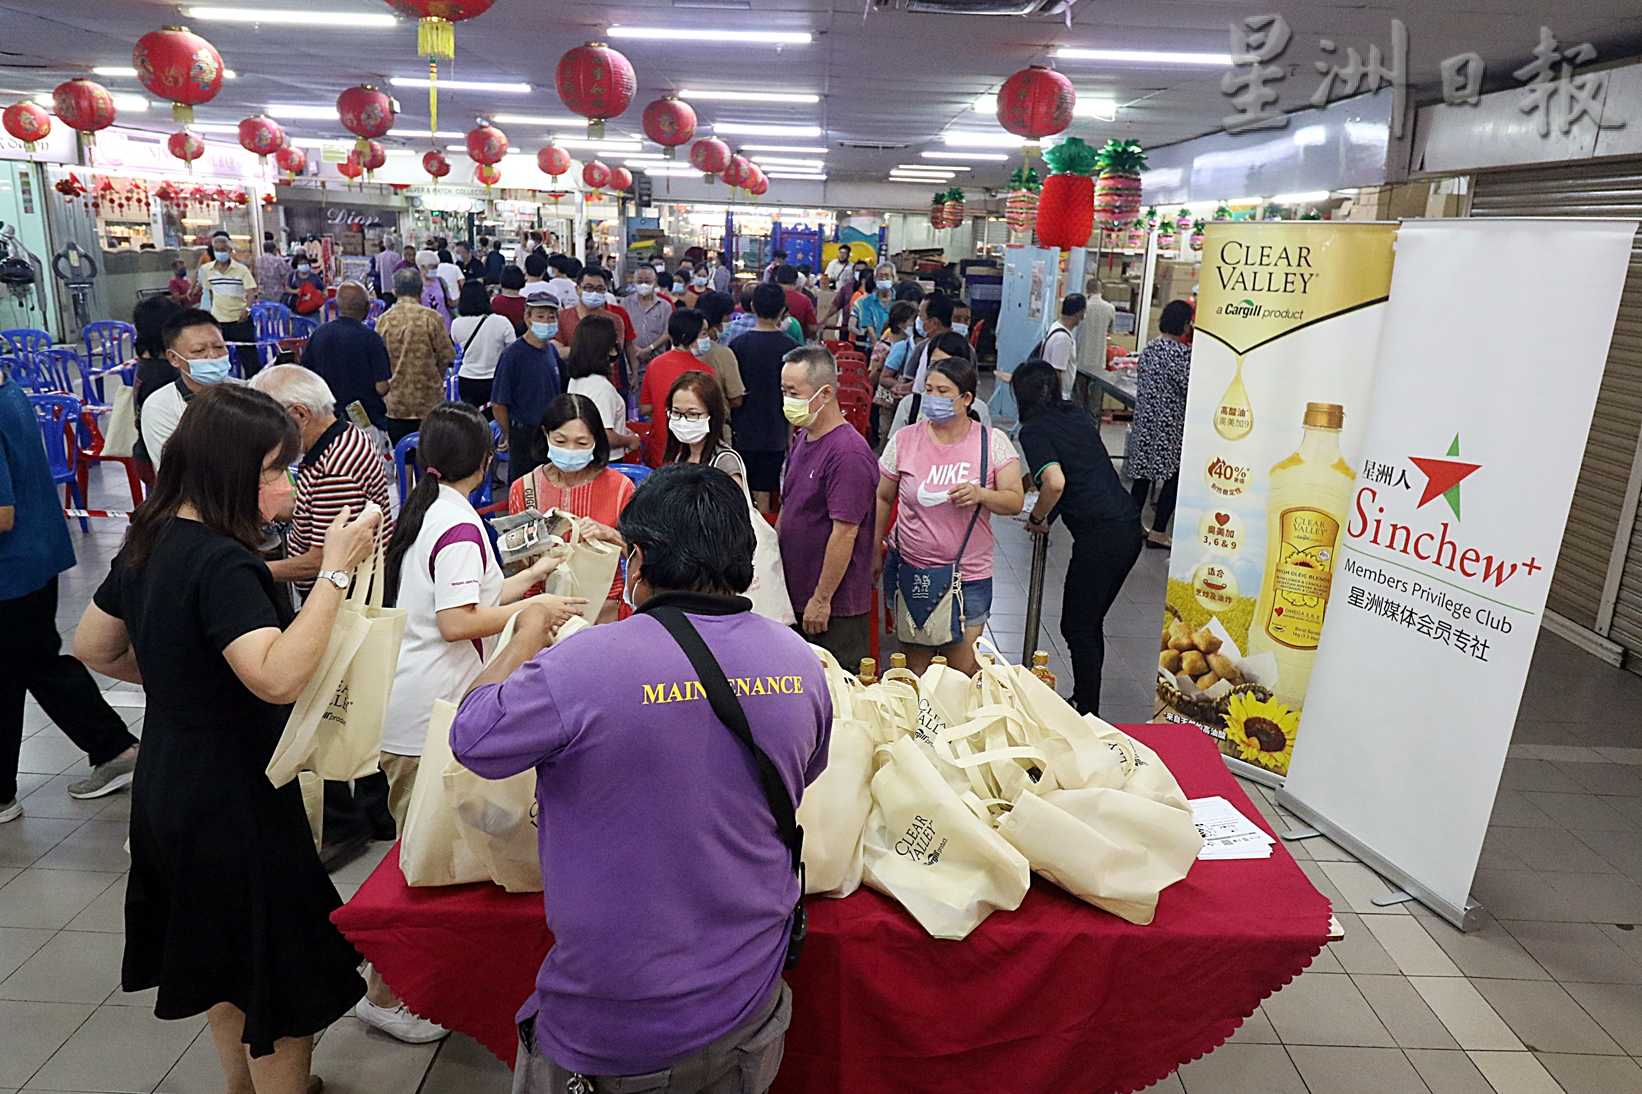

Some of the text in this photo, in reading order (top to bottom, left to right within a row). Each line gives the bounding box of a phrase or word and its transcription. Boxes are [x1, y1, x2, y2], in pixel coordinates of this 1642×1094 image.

[456, 188, 490, 197] COLLECTIO
[1220, 240, 1312, 268] CLEAR
[1216, 265, 1315, 294] VALLEY
[1216, 302, 1304, 320] a Cargill product
[926, 461, 971, 485] NIKE
[1361, 459, 1411, 490] 星洲人
[1207, 525, 1235, 539] 奥美加
[1293, 523, 1326, 536] VALLEY
[1294, 515, 1326, 529] CLEAR
[1203, 535, 1237, 550] 3, 6 & 9
[1276, 568, 1290, 576] HIGH
[1290, 571, 1308, 579] OLEIC
[1344, 558, 1513, 634] Members Privilege Club
[1285, 608, 1306, 617] OMEGA
[1347, 585, 1490, 663] 星洲媒体会员专社
[642, 675, 804, 705] MAINENANCE
[895, 815, 928, 856] CLEAR
